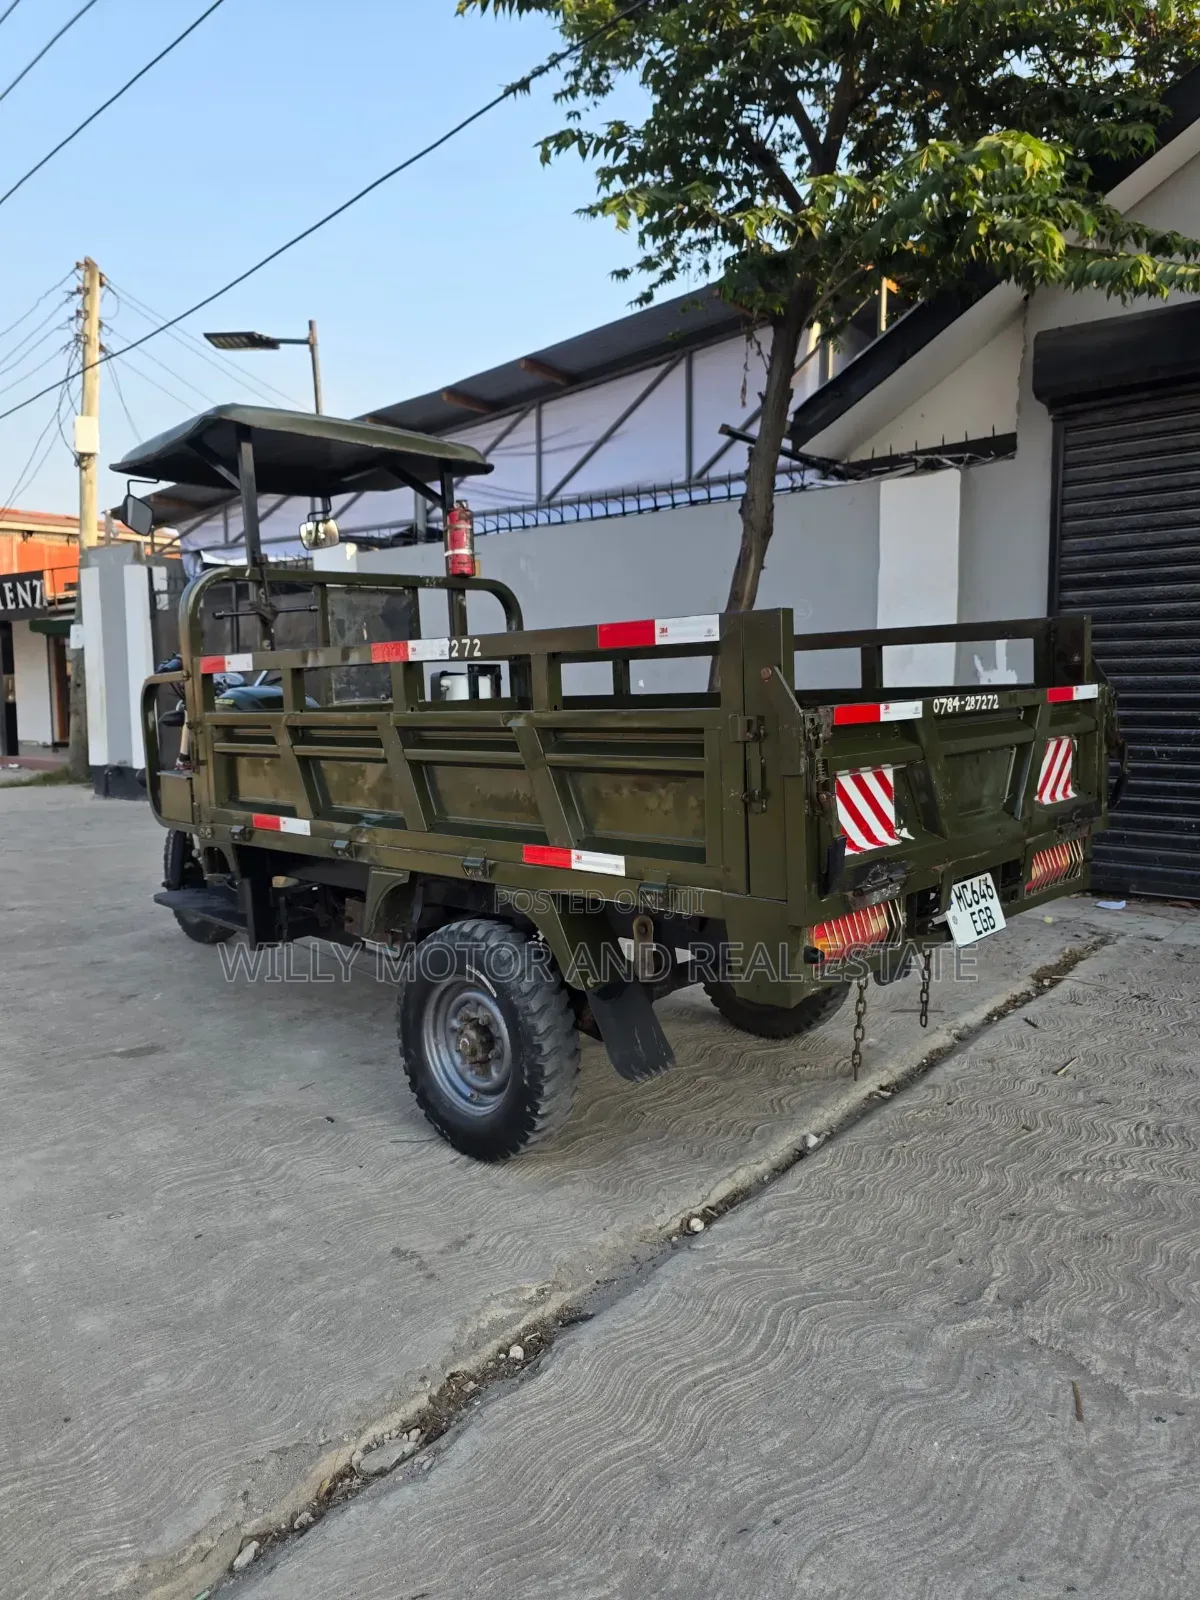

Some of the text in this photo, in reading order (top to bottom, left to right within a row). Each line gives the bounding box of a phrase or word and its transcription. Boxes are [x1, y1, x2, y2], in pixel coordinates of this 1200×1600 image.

[0, 579, 45, 610] ENT
[450, 639, 482, 658] 272
[933, 694, 999, 714] 0784-287272
[952, 876, 995, 913] MC646
[969, 906, 996, 937] EGB
